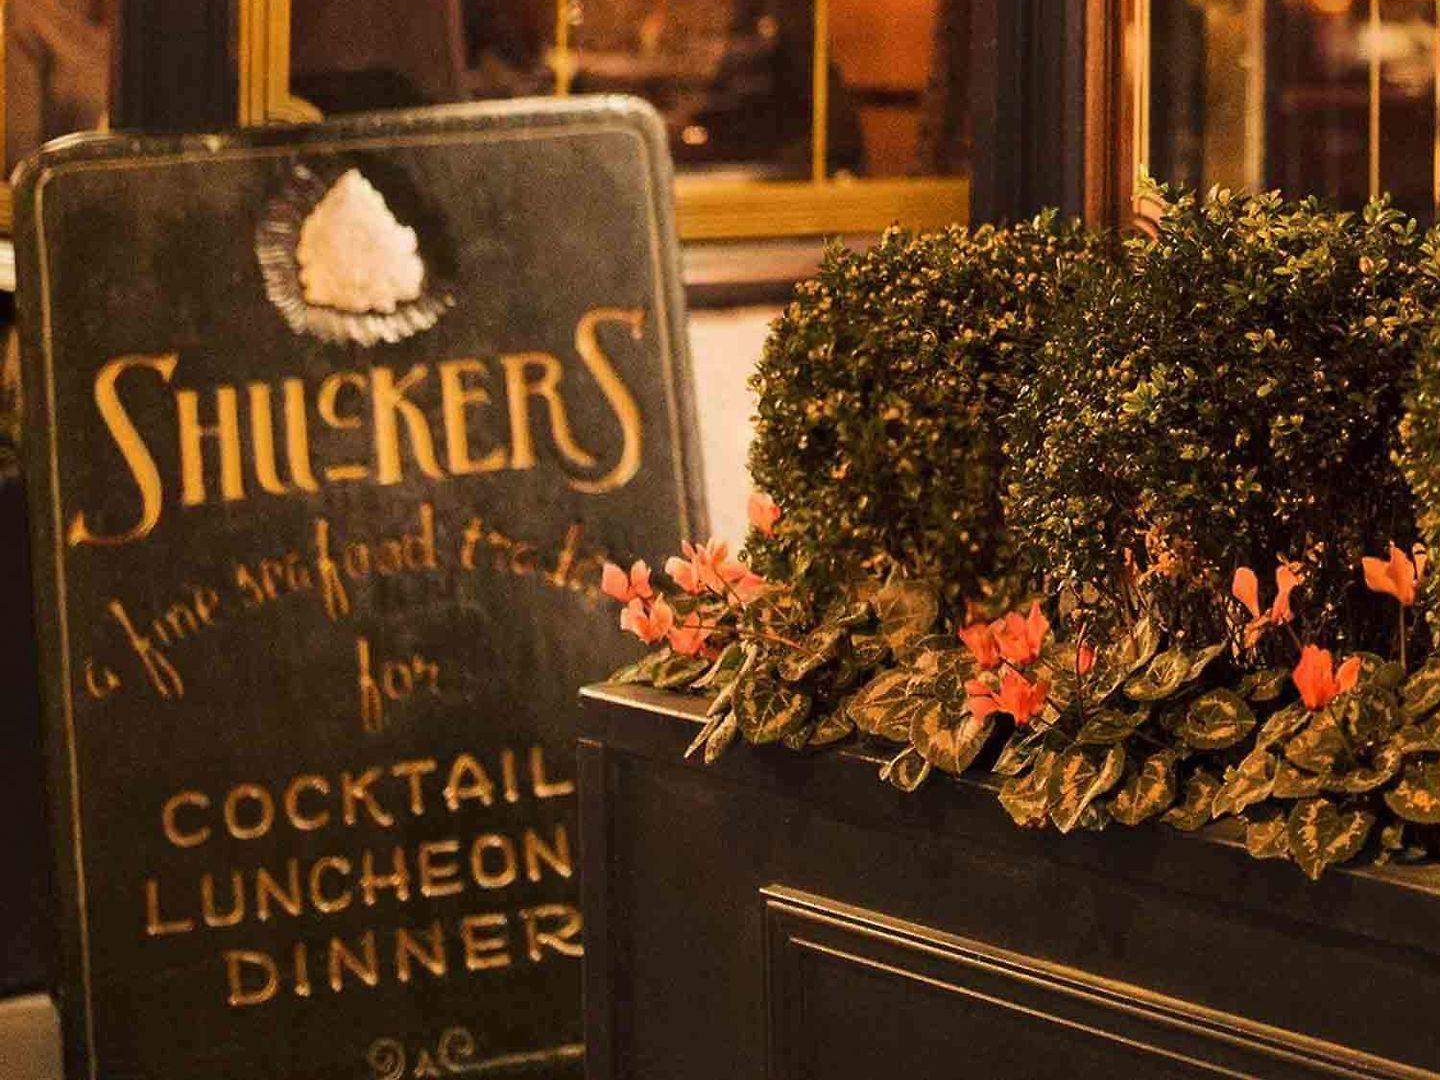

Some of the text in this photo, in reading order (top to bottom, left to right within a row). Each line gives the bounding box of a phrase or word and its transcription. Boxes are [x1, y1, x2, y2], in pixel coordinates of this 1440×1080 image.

[70, 307, 645, 546] SHUCKERS
[83, 656, 122, 699] a
[109, 597, 219, 700] fine
[234, 502, 439, 620] seafood
[355, 634, 440, 734] for
[162, 747, 575, 848] COCKTAIL
[145, 824, 574, 936] LUNCHEON
[222, 904, 585, 1007] DINNER
